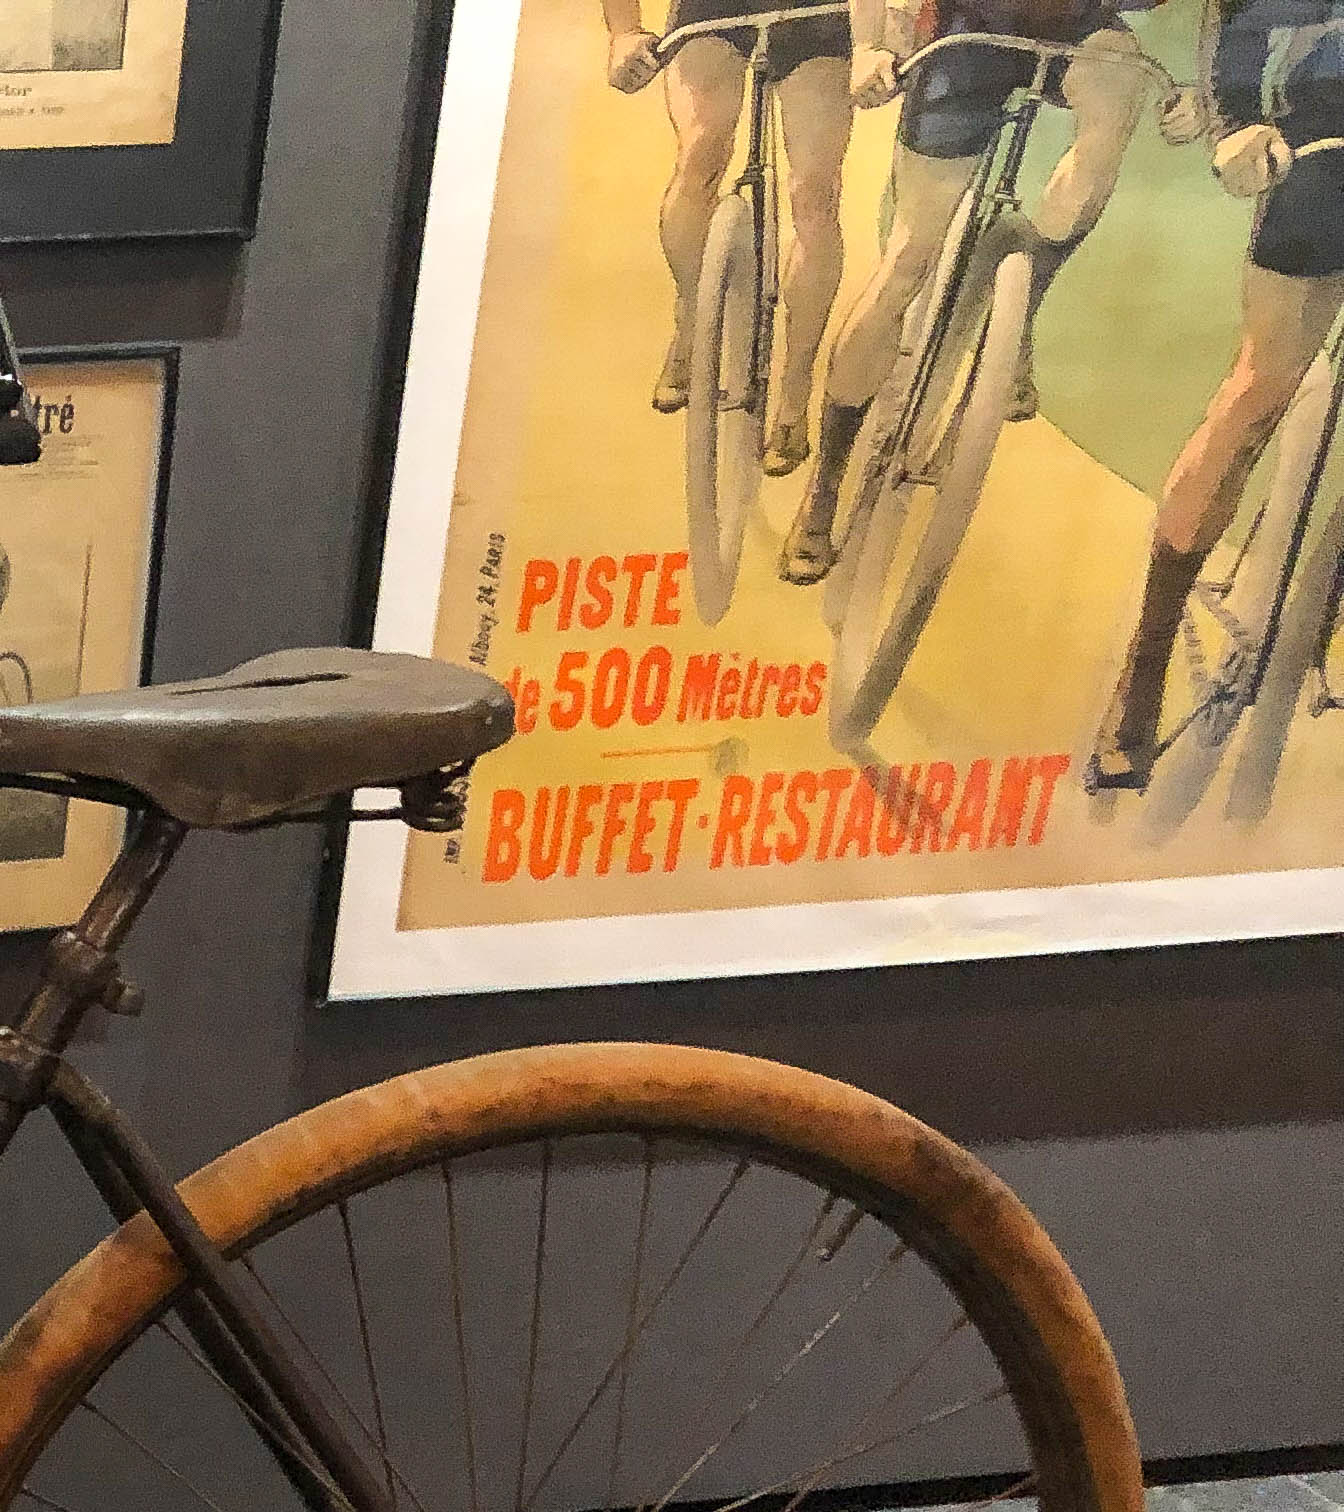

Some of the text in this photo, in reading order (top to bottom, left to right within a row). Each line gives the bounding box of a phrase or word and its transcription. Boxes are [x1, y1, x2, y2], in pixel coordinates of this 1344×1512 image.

[479, 532, 507, 579] PARIS
[516, 552, 690, 634] PISTE
[548, 645, 673, 732] 500
[676, 650, 828, 722] Mètres
